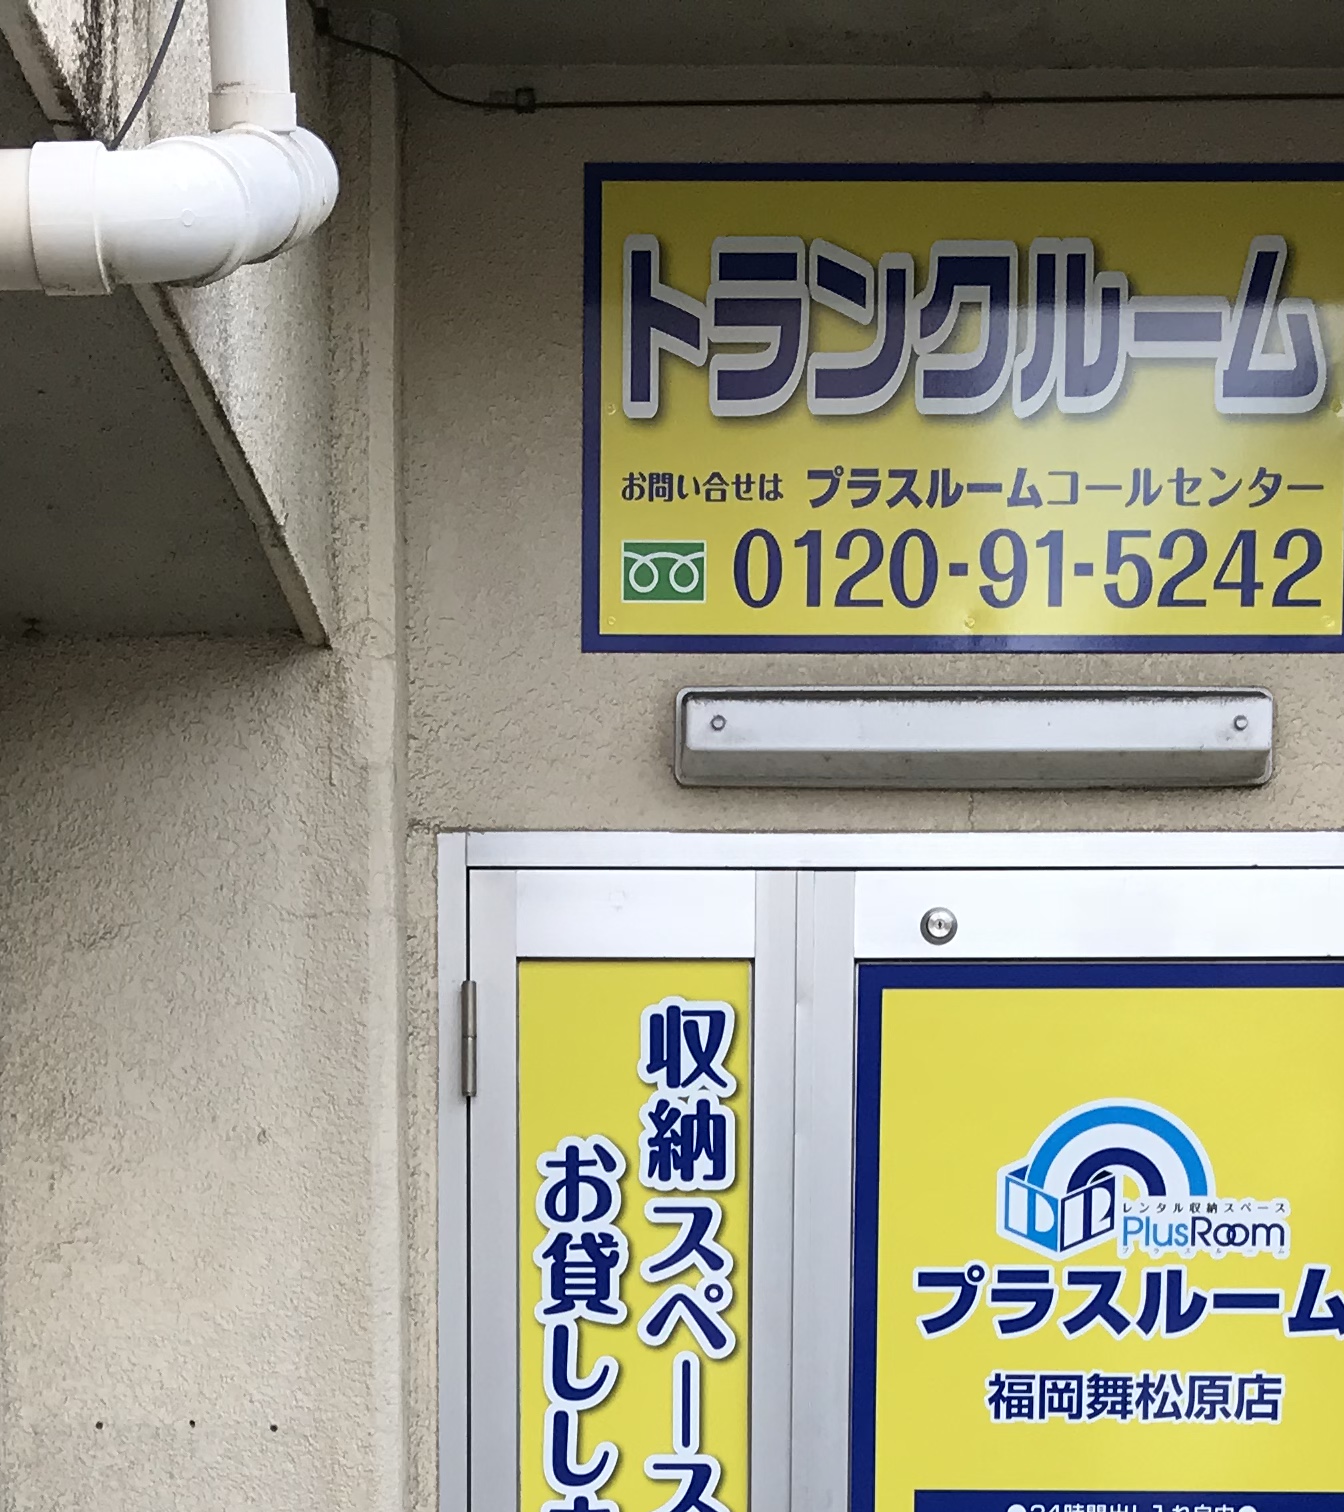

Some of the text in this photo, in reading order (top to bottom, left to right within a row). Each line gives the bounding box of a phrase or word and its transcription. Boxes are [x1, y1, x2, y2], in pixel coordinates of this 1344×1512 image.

[625, 236, 1324, 416] トランクルーム
[622, 466, 1324, 509] お問い合せは プラスルームコールセンター
[733, 528, 1323, 609] 0120-91-5242
[1123, 1202, 1286, 1214] レンタル収納スペース
[1123, 1216, 1285, 1247] PlusRoom
[987, 1371, 1283, 1422] 福岡舞松原店
